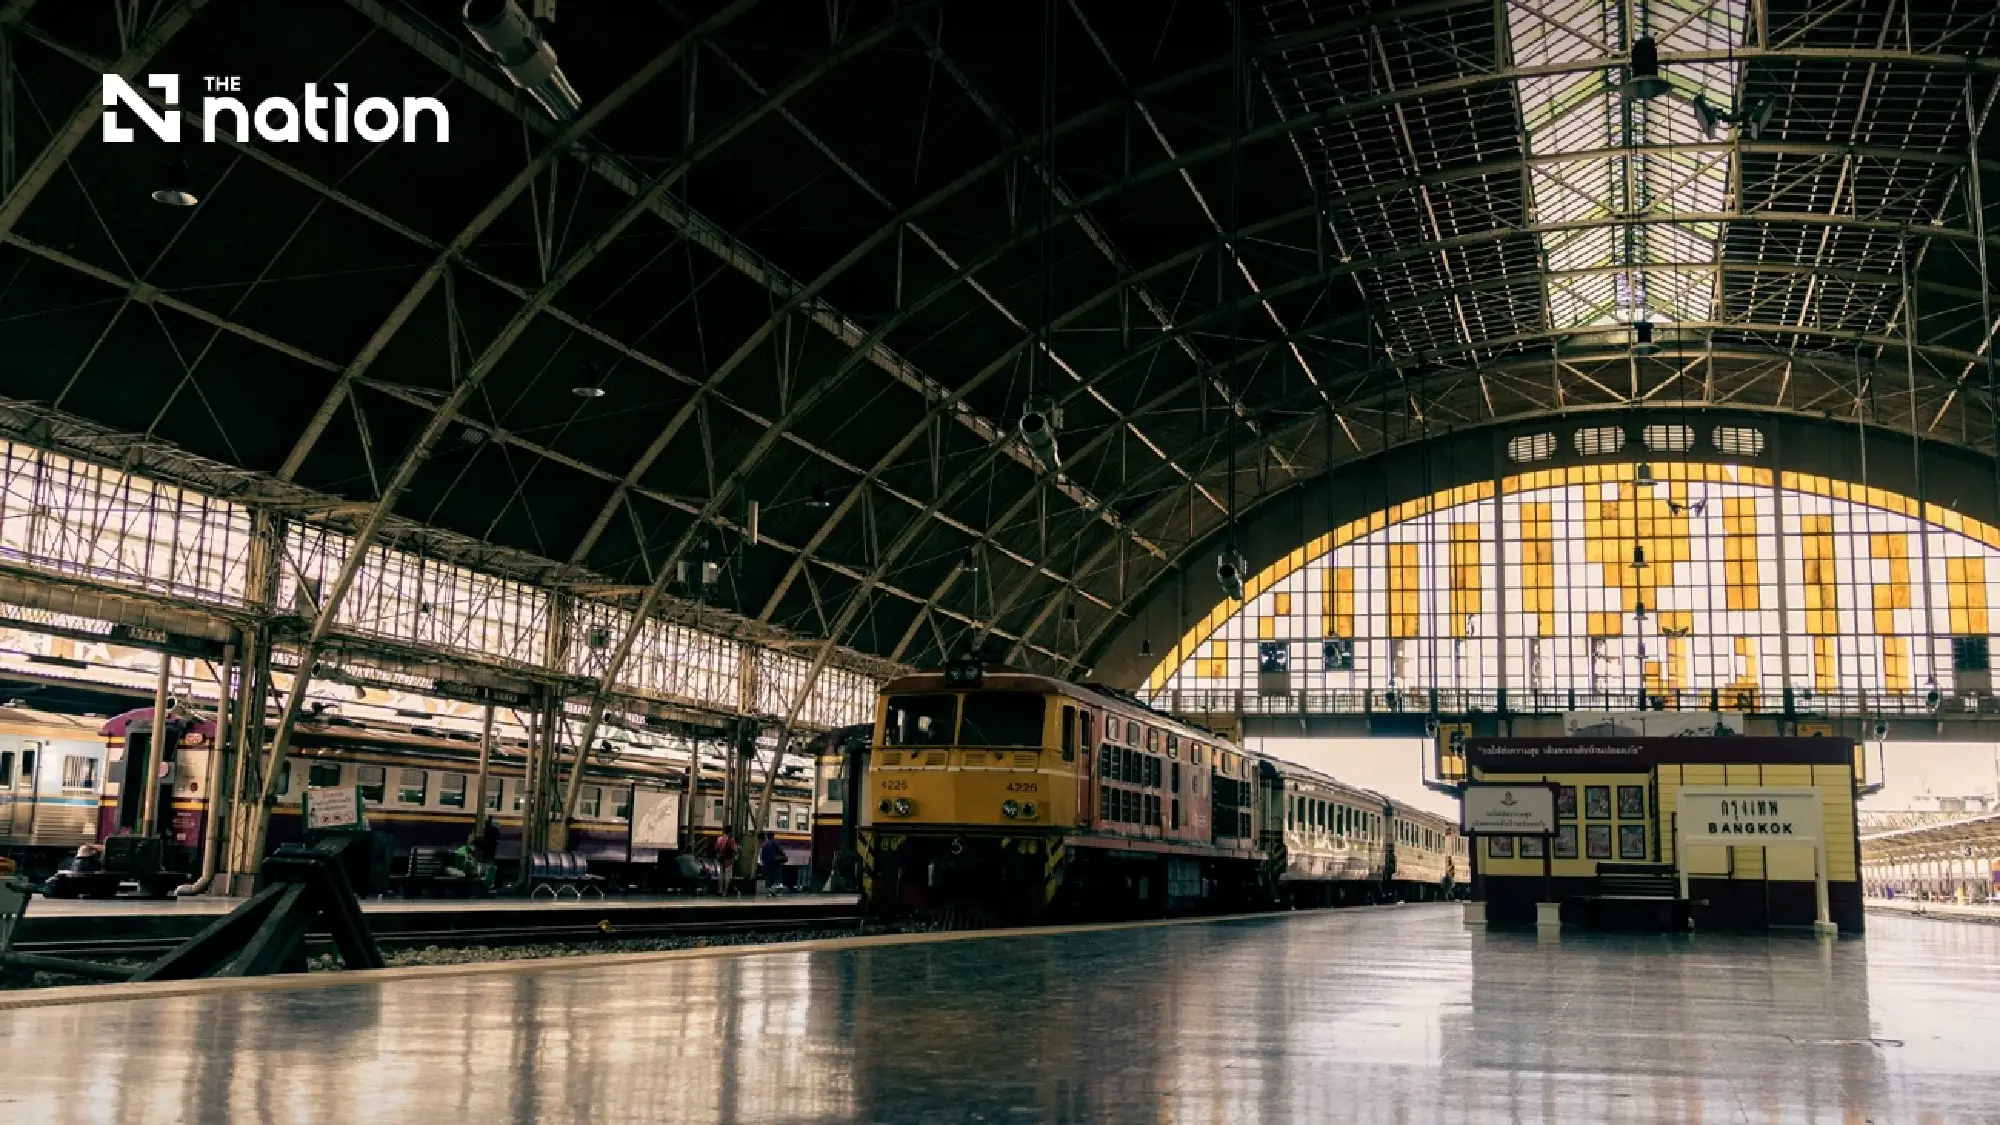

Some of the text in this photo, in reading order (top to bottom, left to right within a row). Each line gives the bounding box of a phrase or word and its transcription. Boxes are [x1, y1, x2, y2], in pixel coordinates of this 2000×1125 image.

[881, 780, 908, 791] 4226
[1006, 782, 1038, 793] 4226
[1721, 800, 1778, 822] กรุงเทพ
[1708, 823, 1793, 834] BANGKOK
